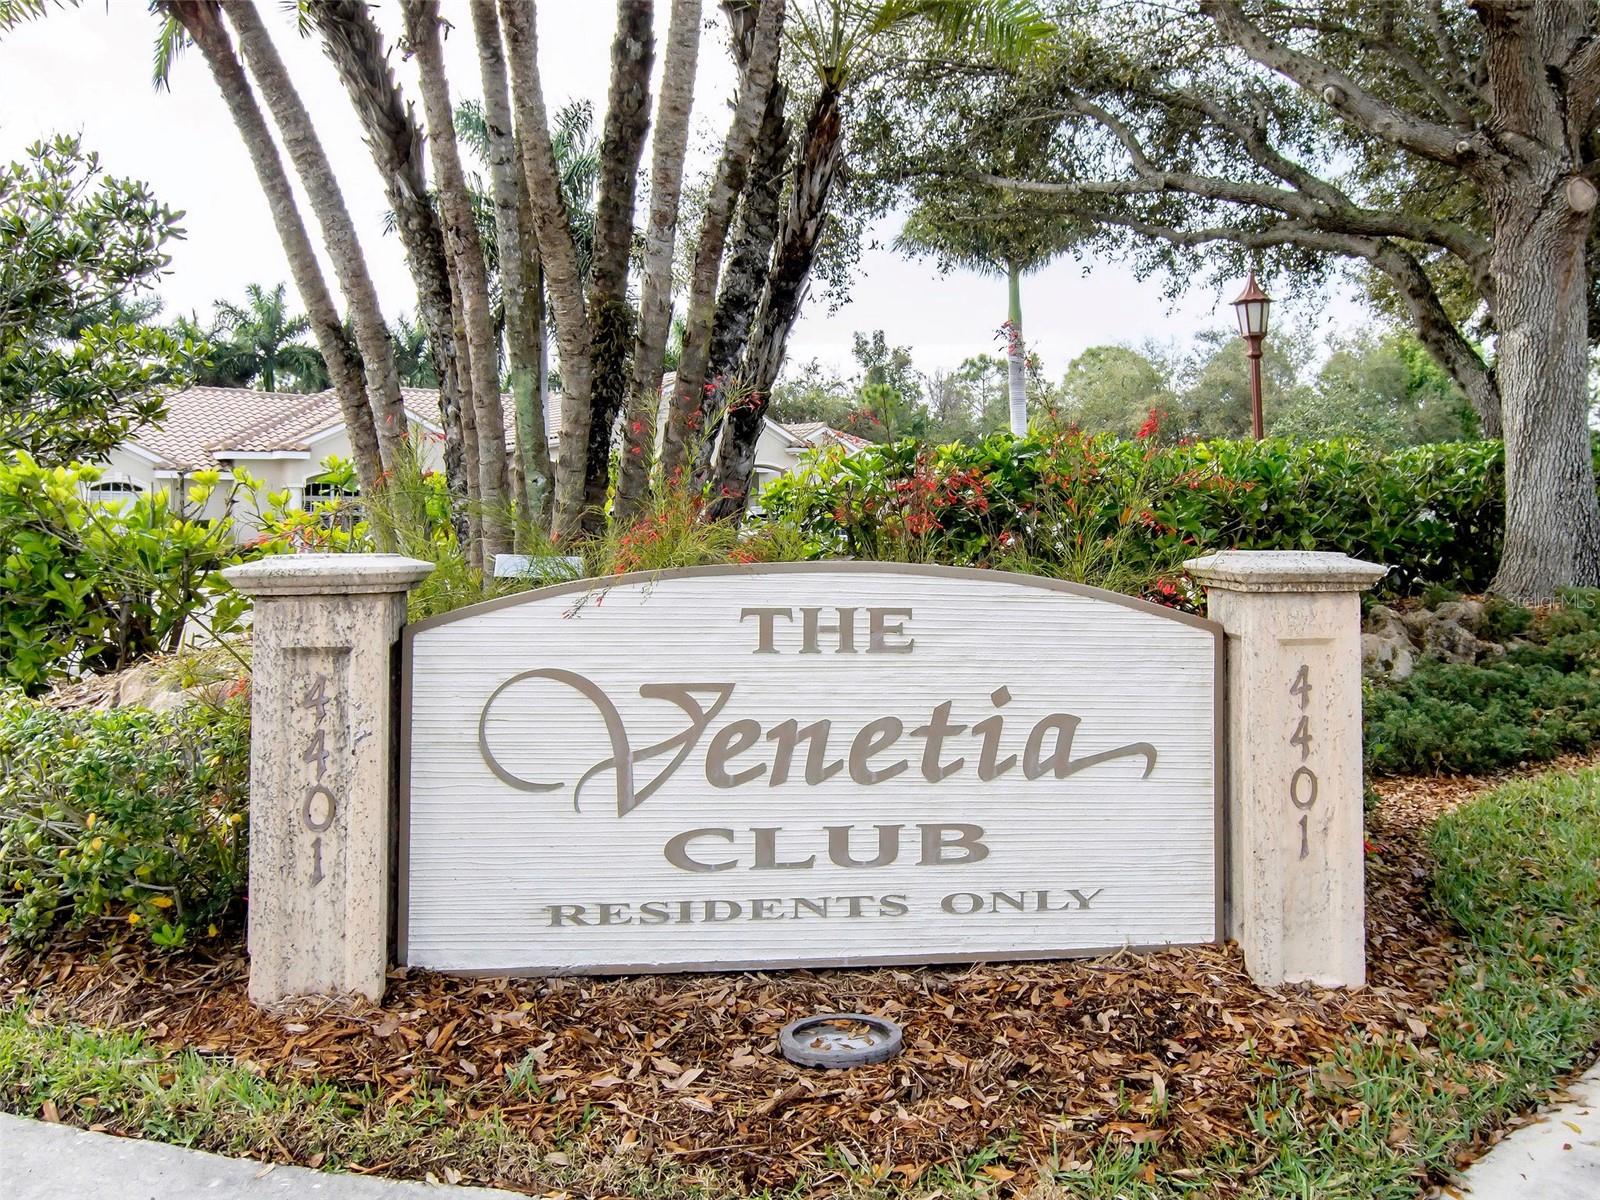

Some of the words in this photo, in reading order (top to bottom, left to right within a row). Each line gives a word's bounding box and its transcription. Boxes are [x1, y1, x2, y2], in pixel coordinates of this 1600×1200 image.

[740, 607, 915, 654] THE
[302, 675, 337, 888] 4401
[479, 668, 1157, 818] Venetia
[1289, 664, 1319, 860] 4401
[664, 822, 990, 872] CLUB
[543, 894, 909, 927] RESIDENTS
[940, 888, 1105, 915] ONLY
